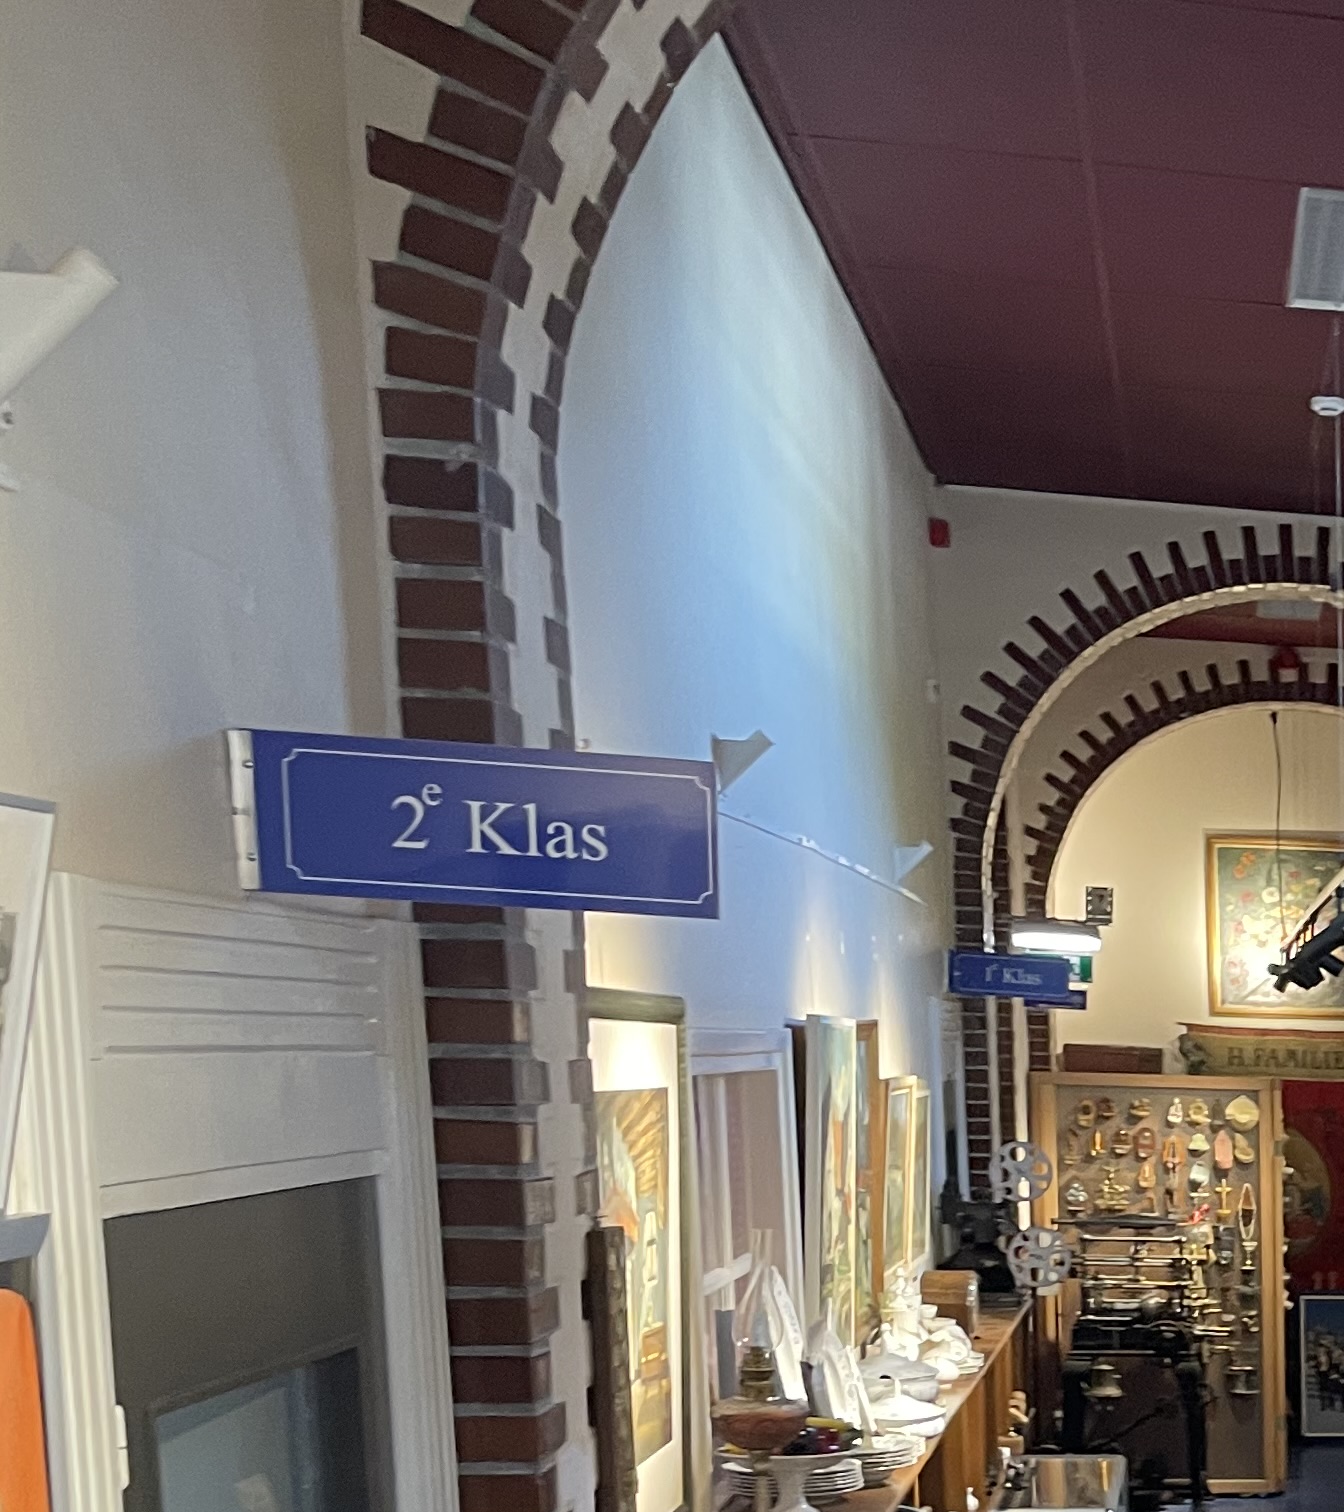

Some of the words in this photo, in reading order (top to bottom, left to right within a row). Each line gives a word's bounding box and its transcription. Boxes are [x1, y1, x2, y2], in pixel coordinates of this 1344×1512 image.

[391, 783, 443, 849] 2e
[463, 799, 609, 862] Klas
[1002, 967, 1042, 985] Klas
